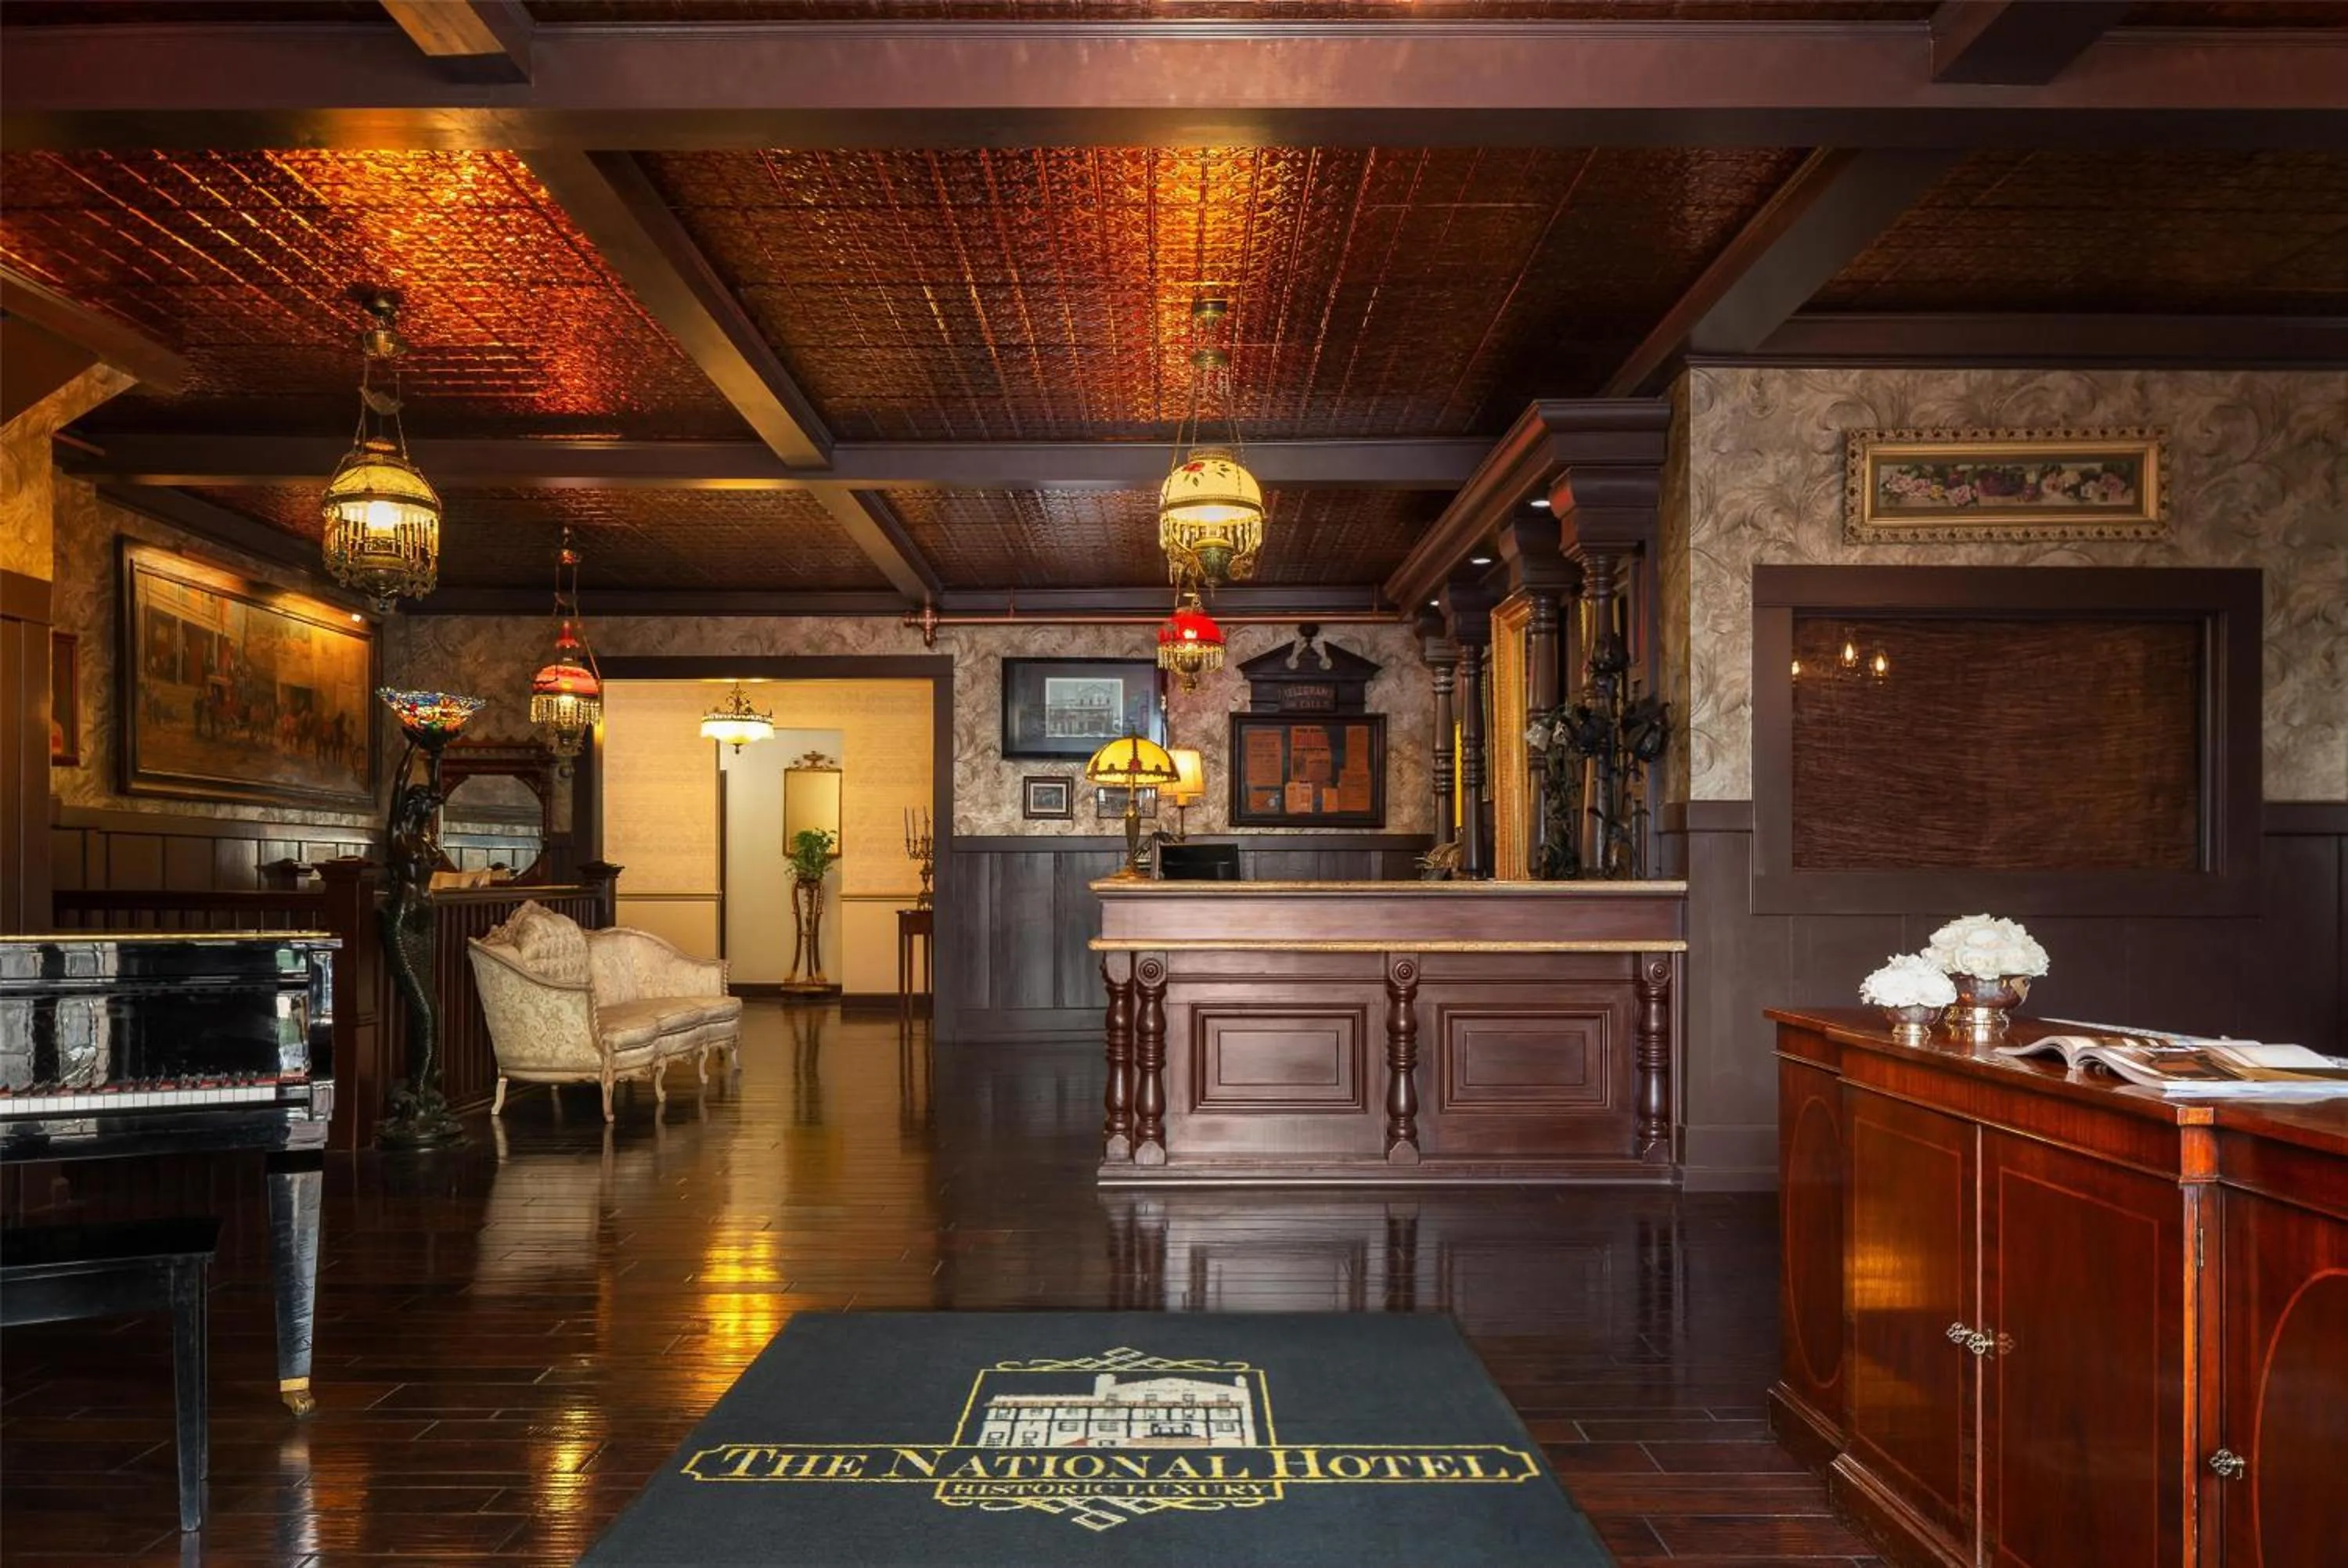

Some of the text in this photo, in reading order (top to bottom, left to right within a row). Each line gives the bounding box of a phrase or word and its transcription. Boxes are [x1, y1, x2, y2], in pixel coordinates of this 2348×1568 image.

[719, 1448, 1508, 1478] THE NATIONAL HOTEL
[953, 1482, 1269, 1496] HISTORIC LUXURY
